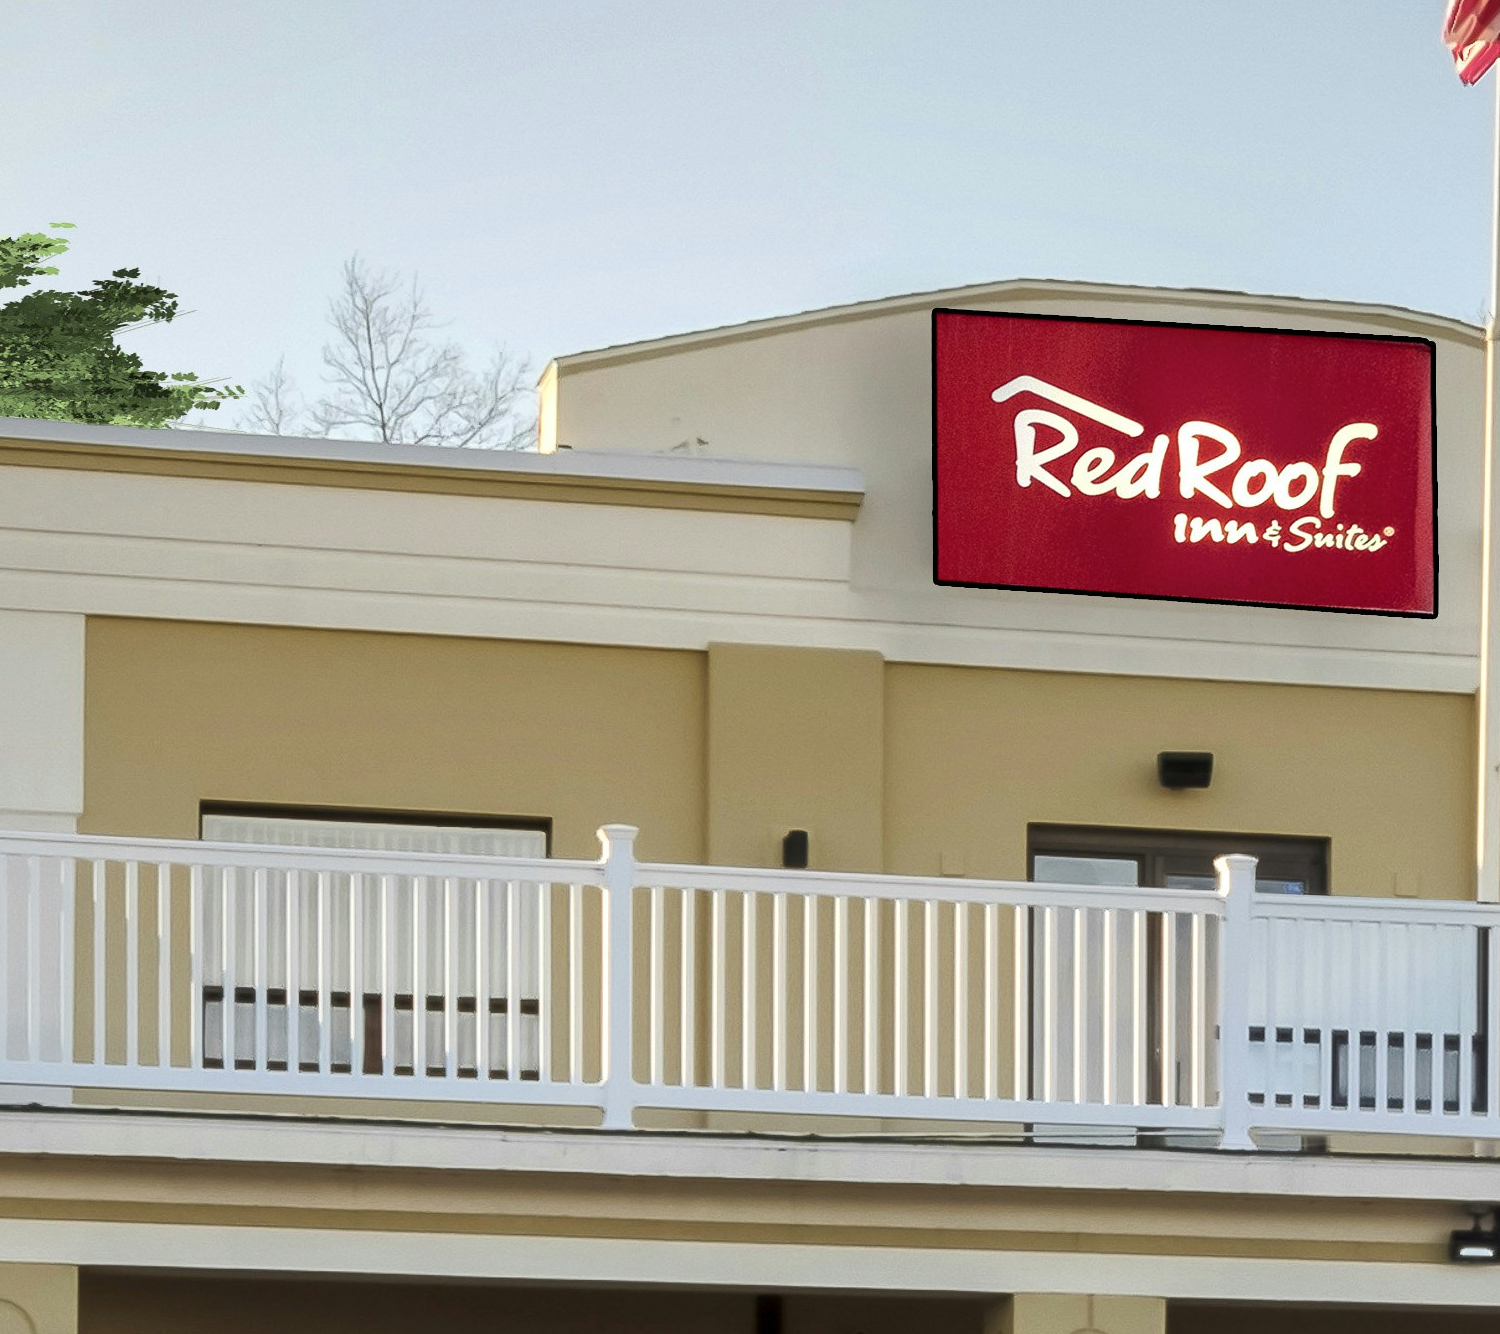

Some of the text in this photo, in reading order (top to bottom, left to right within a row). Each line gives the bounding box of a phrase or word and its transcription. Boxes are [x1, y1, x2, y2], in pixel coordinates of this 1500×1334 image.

[1173, 512, 1388, 553] Inn & Suites
